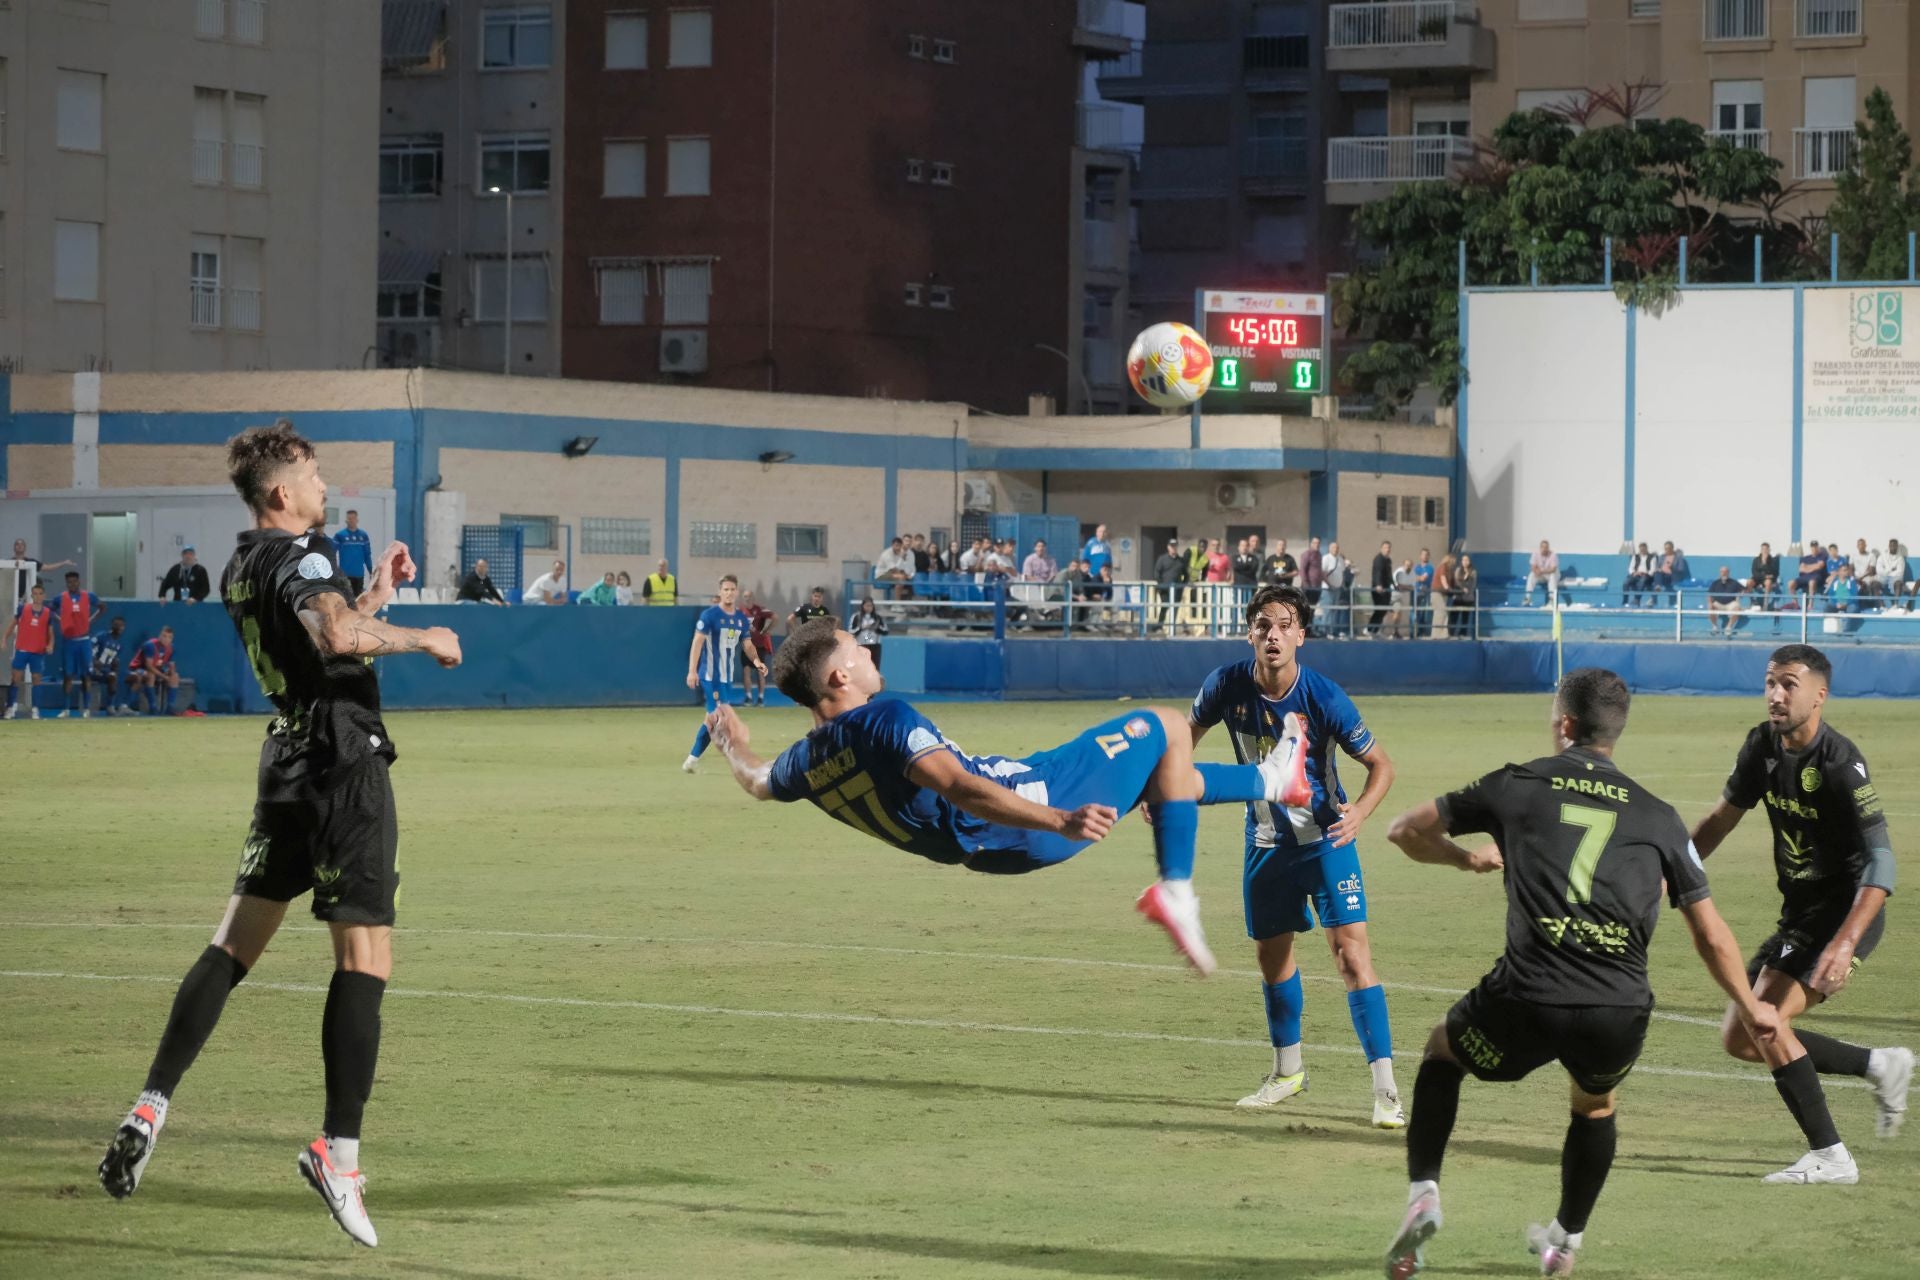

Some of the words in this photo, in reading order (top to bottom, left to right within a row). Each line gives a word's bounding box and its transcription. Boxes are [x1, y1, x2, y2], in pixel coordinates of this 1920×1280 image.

[1230, 318, 1298, 345] 45:00
[1281, 348, 1321, 360] VISITANTE
[1221, 359, 1237, 386] 0
[1296, 361, 1312, 389] 0
[1552, 777, 1630, 803] DARACE
[819, 769, 913, 847] 17
[1560, 803, 1618, 904] 7
[1337, 879, 1361, 891] CRC
